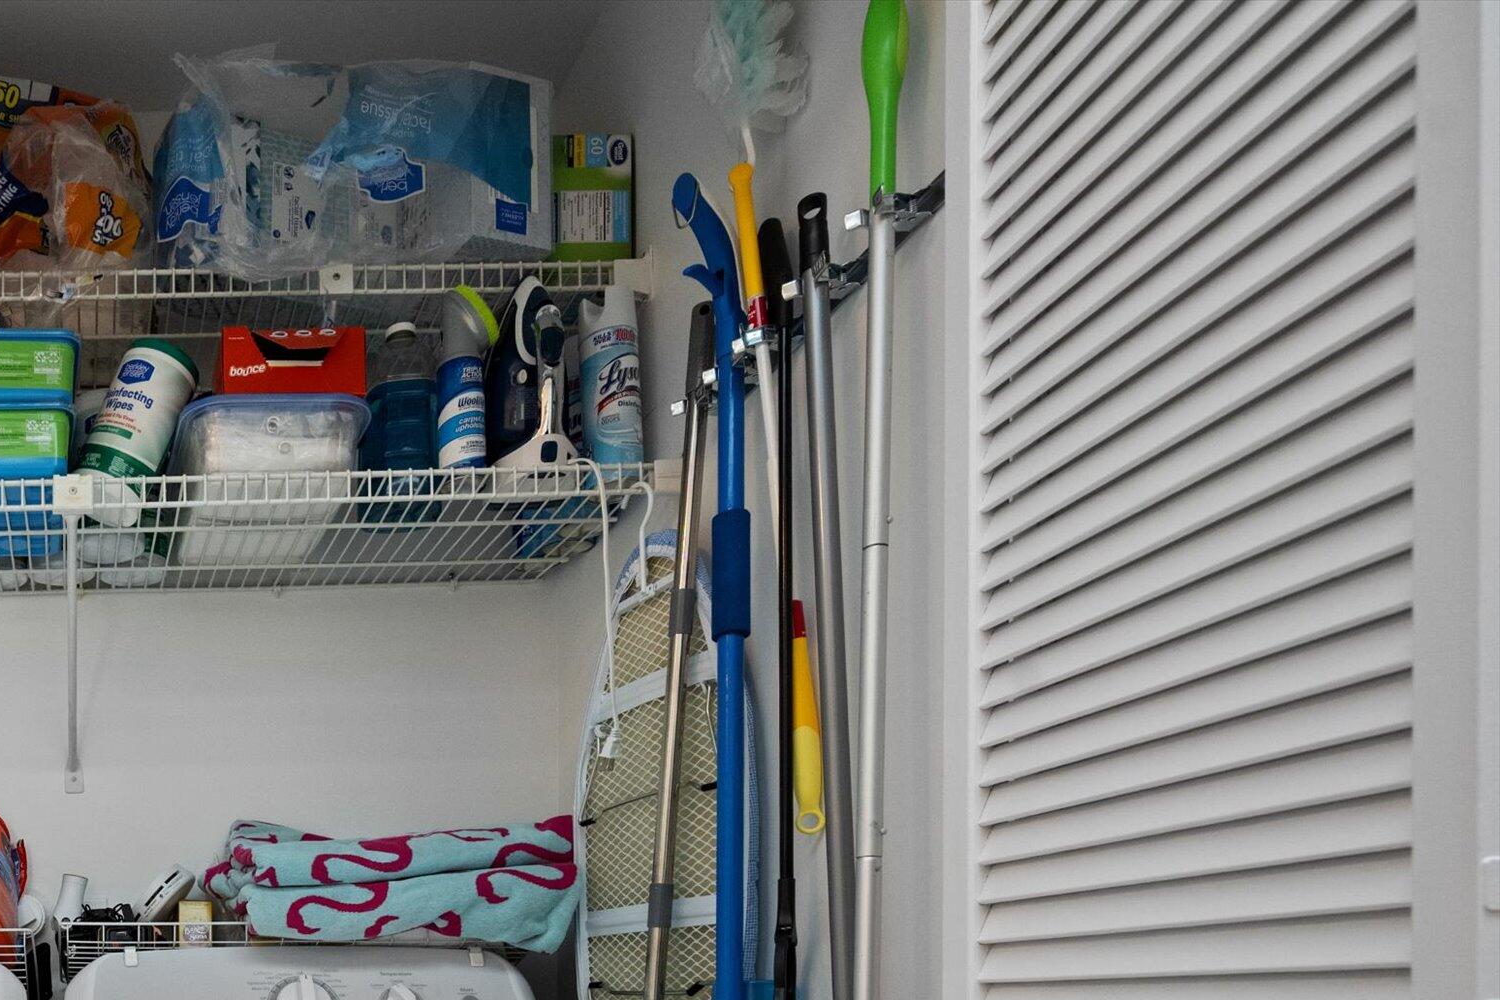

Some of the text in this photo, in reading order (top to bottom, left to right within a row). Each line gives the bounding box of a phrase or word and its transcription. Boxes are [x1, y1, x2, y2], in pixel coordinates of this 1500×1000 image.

[590, 137, 605, 156] 60
[229, 363, 267, 378] bounce
[105, 398, 134, 411] Wipes
